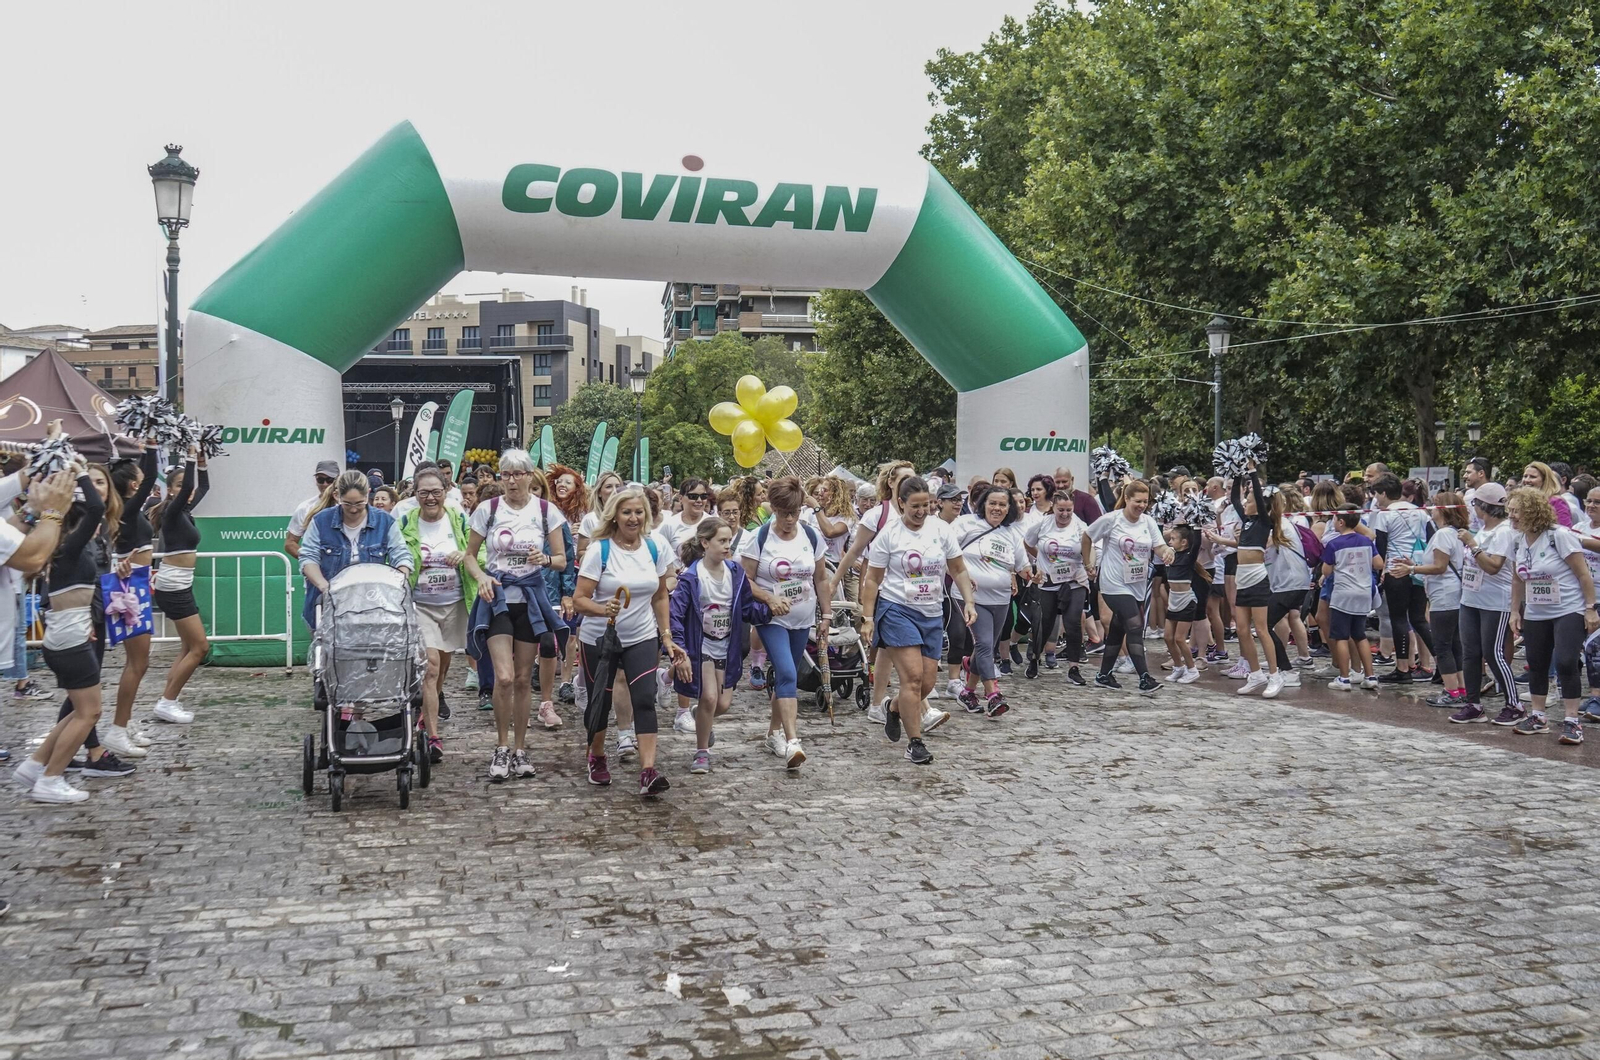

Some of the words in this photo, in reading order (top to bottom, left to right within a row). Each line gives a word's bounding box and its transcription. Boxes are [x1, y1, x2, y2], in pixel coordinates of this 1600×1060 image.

[407, 311, 432, 321] TEL
[221, 418, 326, 444] OVIRAN
[220, 528, 288, 540] www.covir
[428, 574, 447, 584] 2570
[784, 586, 802, 598] 1650
[918, 584, 929, 593] 52
[1532, 586, 1551, 595] 2260
[713, 618, 730, 628] 1649
